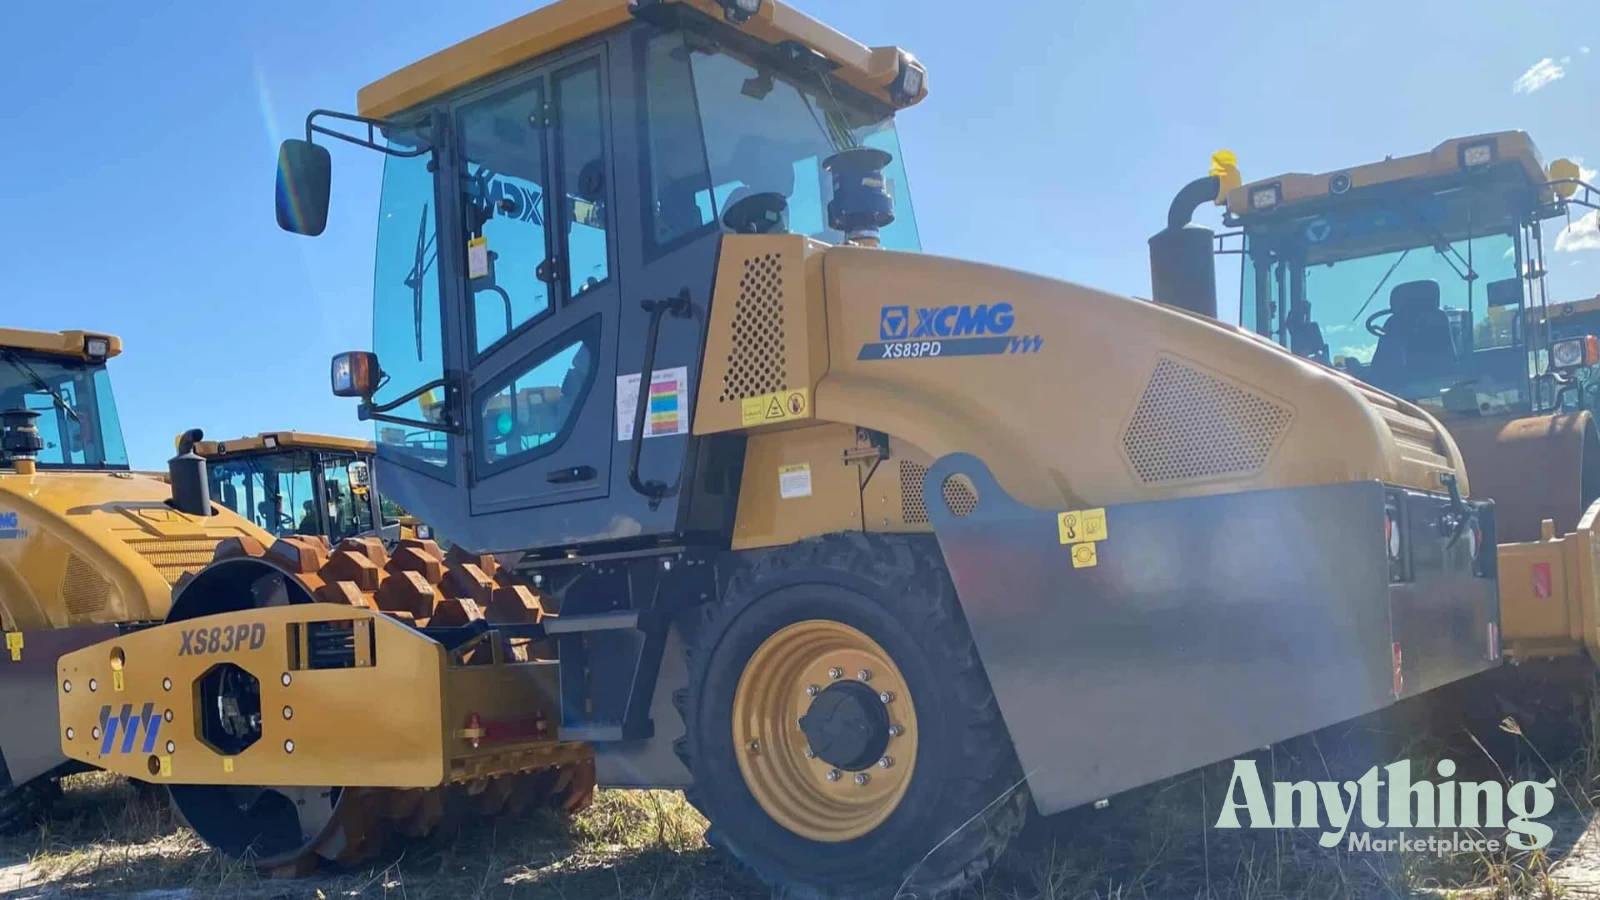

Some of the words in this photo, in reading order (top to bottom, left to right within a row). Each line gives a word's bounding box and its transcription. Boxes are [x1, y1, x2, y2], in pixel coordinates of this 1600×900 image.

[909, 302, 1015, 338] XCMG
[882, 341, 942, 359] XS83PD
[178, 623, 266, 656] XS83PD
